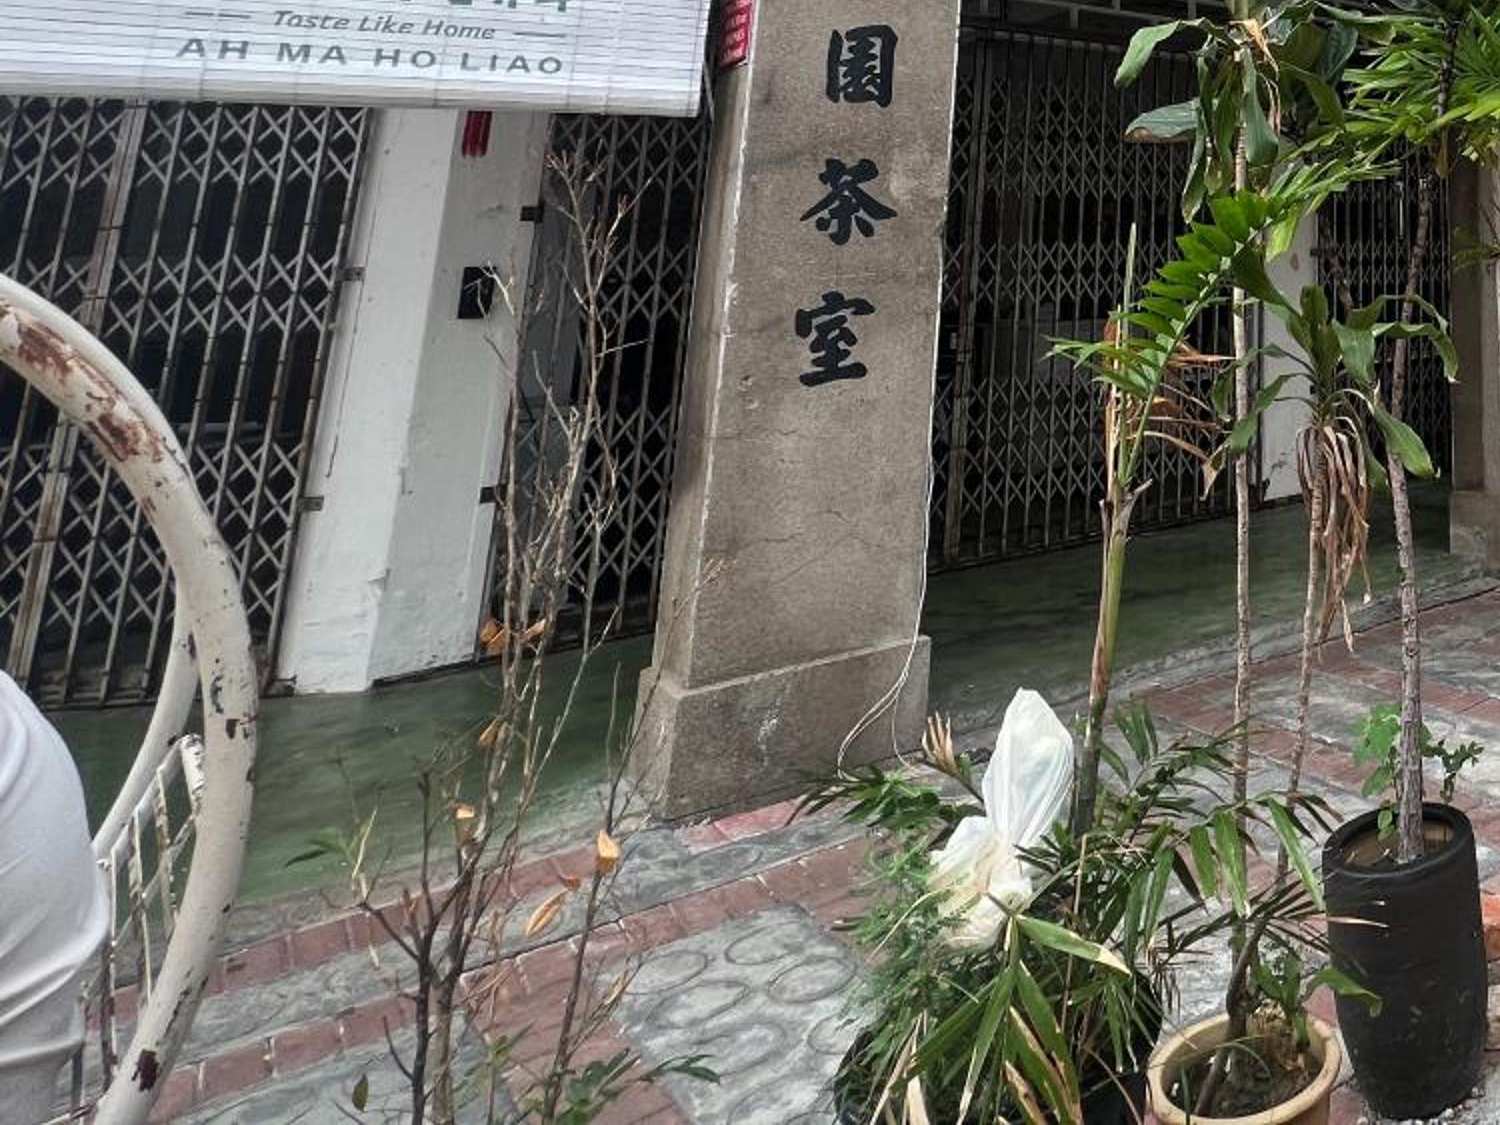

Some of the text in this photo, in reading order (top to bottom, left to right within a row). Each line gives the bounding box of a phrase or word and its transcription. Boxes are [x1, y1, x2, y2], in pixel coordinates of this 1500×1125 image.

[272, 10, 496, 40] Taste Like Home
[176, 38, 563, 74] AH MA HO LIAO
